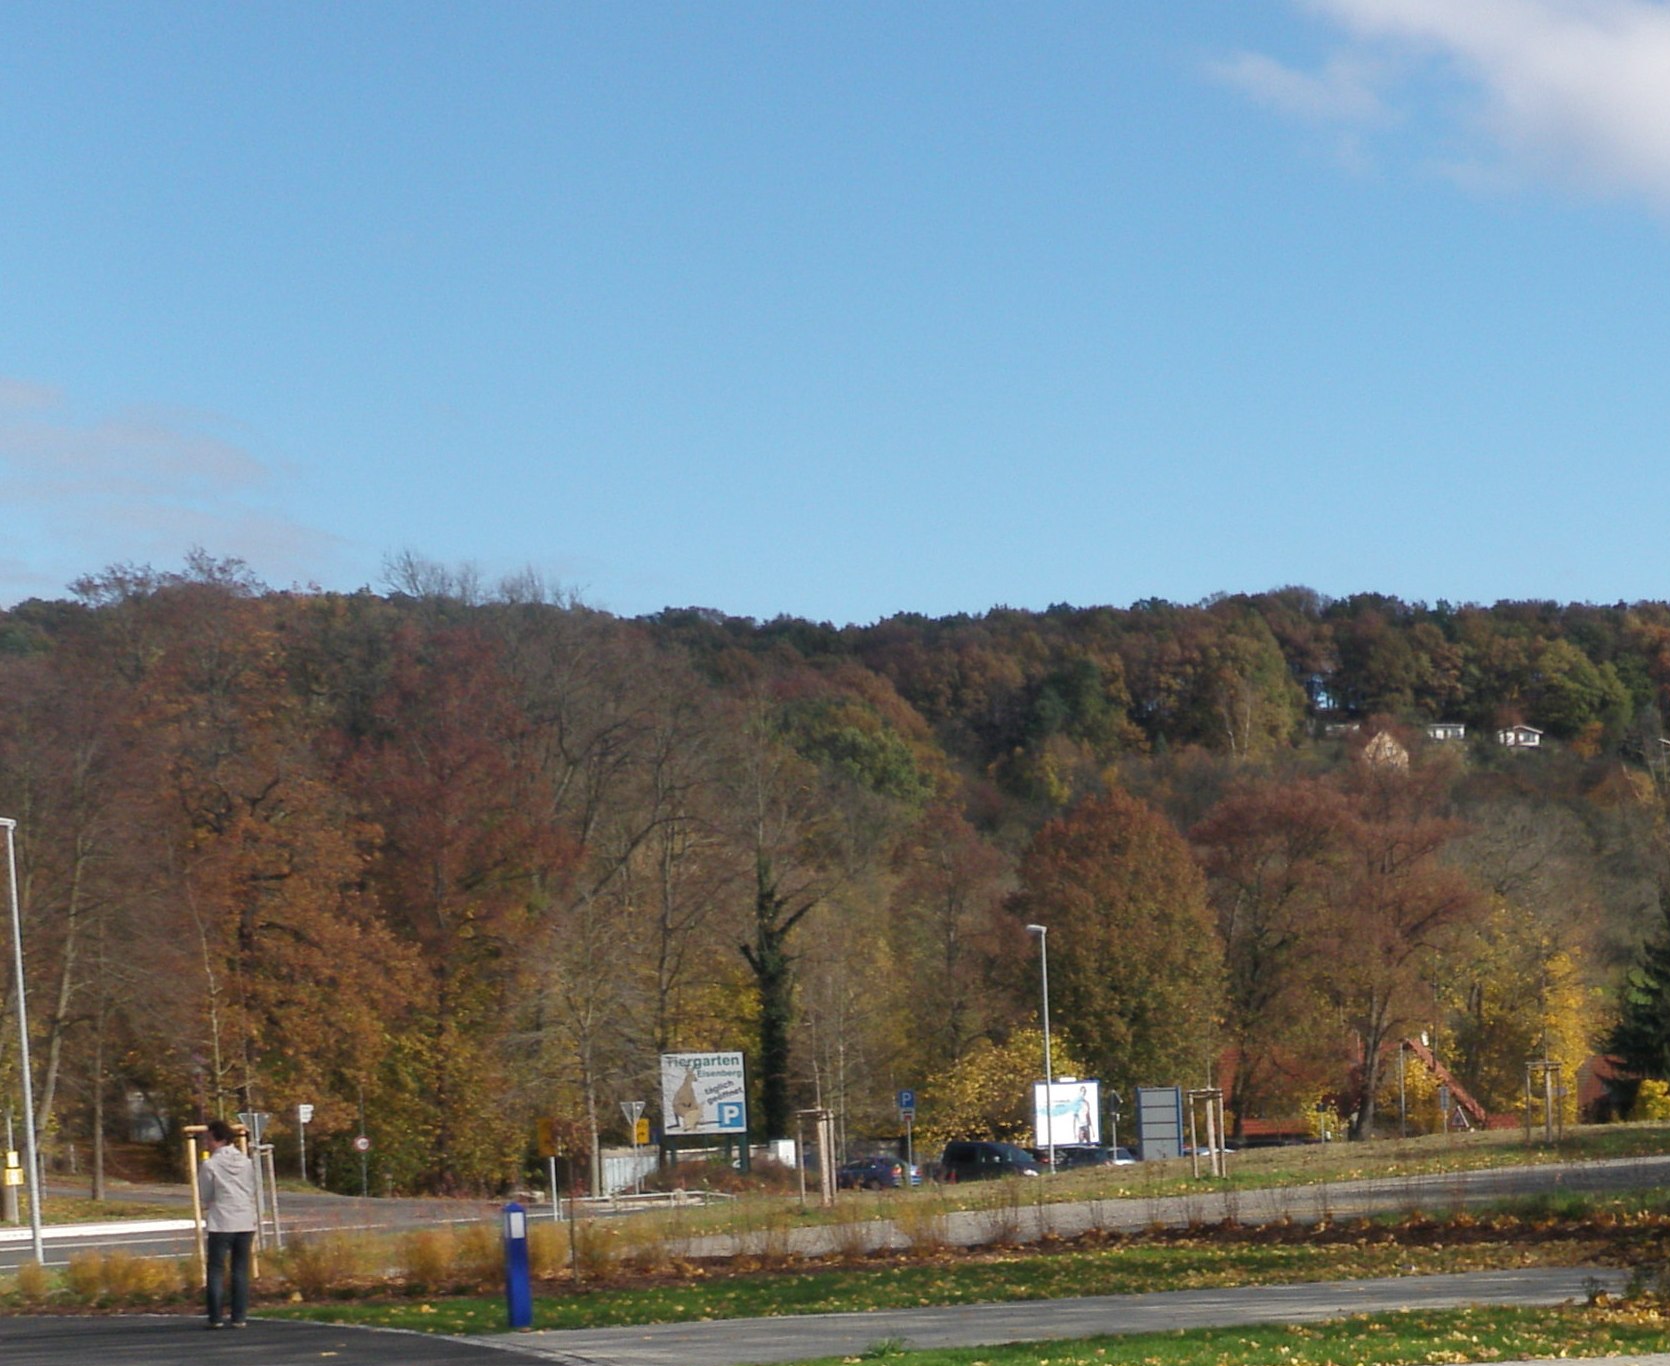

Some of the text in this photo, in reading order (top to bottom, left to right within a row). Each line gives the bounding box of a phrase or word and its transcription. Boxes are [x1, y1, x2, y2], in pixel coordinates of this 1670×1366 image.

[667, 1056, 739, 1069] Tiergarten
[697, 1069, 742, 1078] Eisenberg
[902, 1092, 912, 1106] P
[724, 1106, 739, 1124] P
